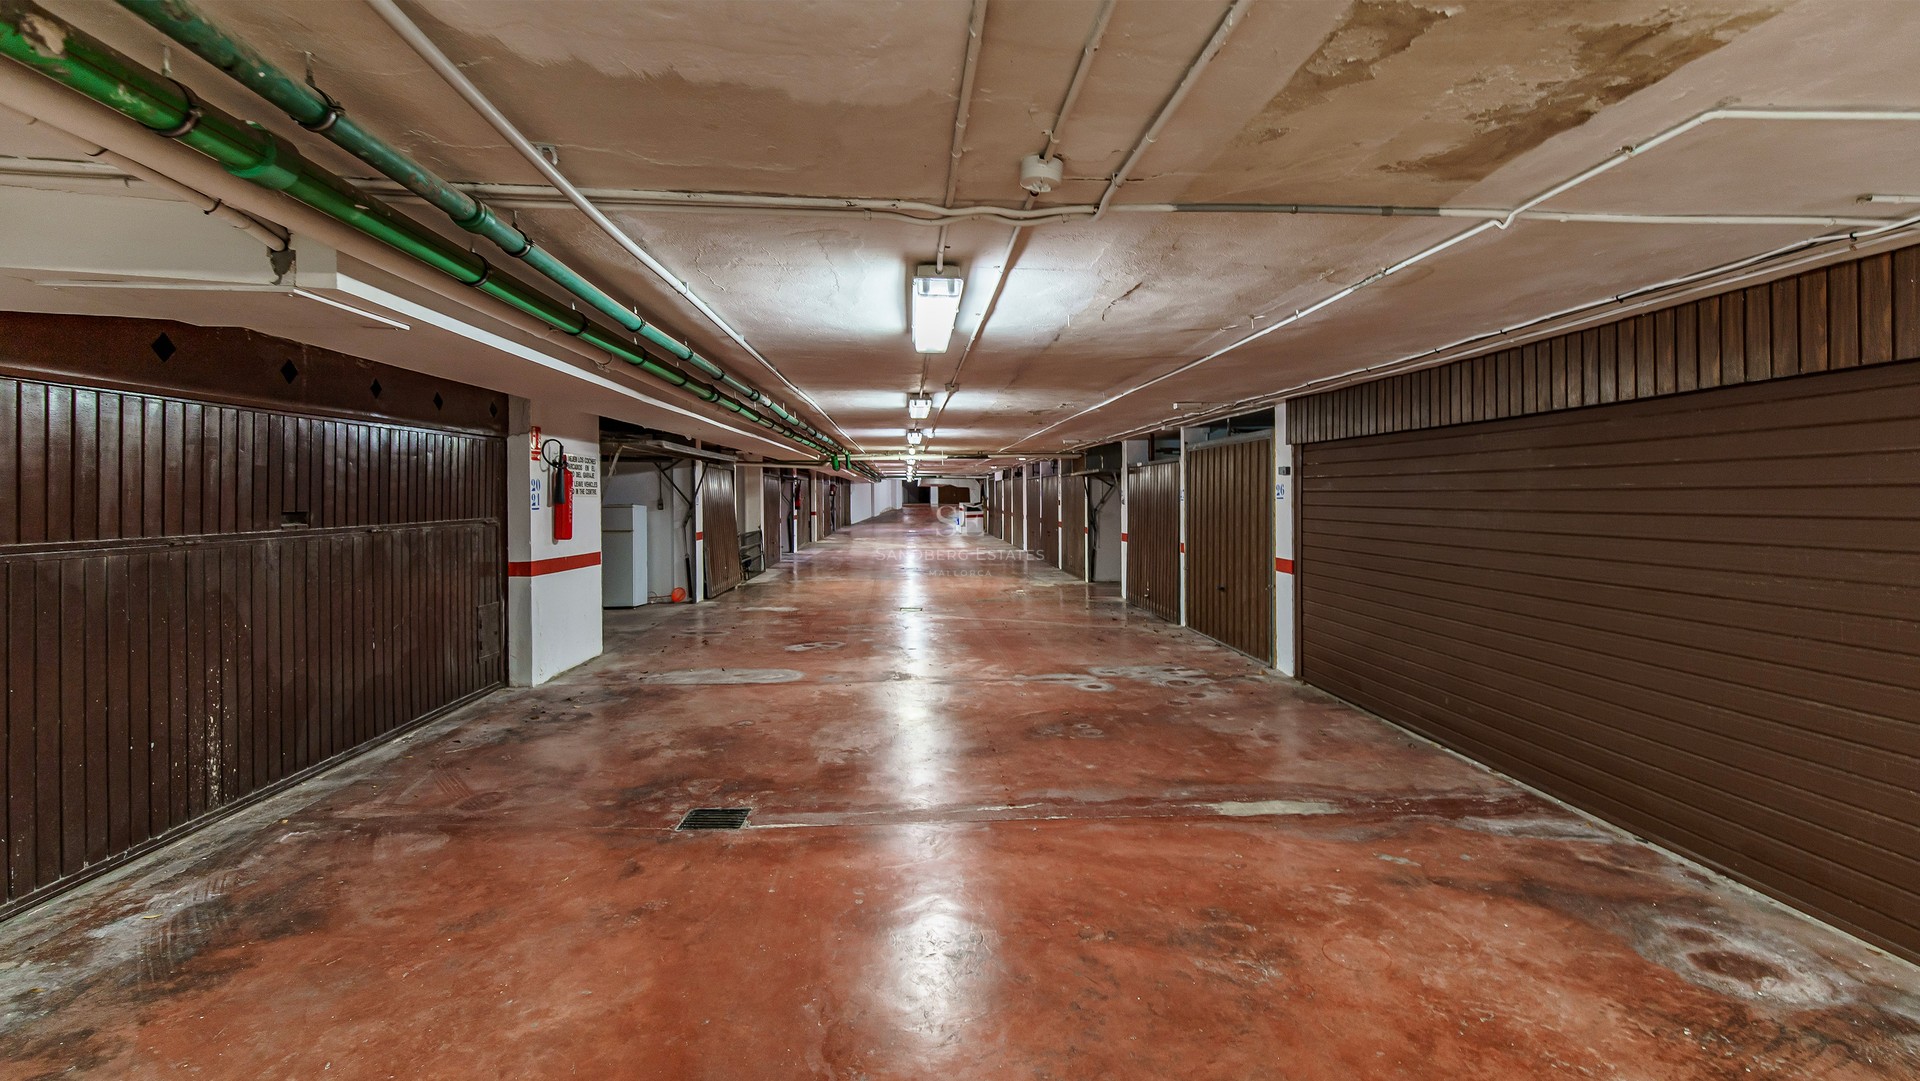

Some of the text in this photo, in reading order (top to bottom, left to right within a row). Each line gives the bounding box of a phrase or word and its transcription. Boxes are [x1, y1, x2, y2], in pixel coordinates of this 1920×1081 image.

[531, 479, 540, 491] 20
[1276, 484, 1285, 496] 26
[532, 493, 540, 506] 21
